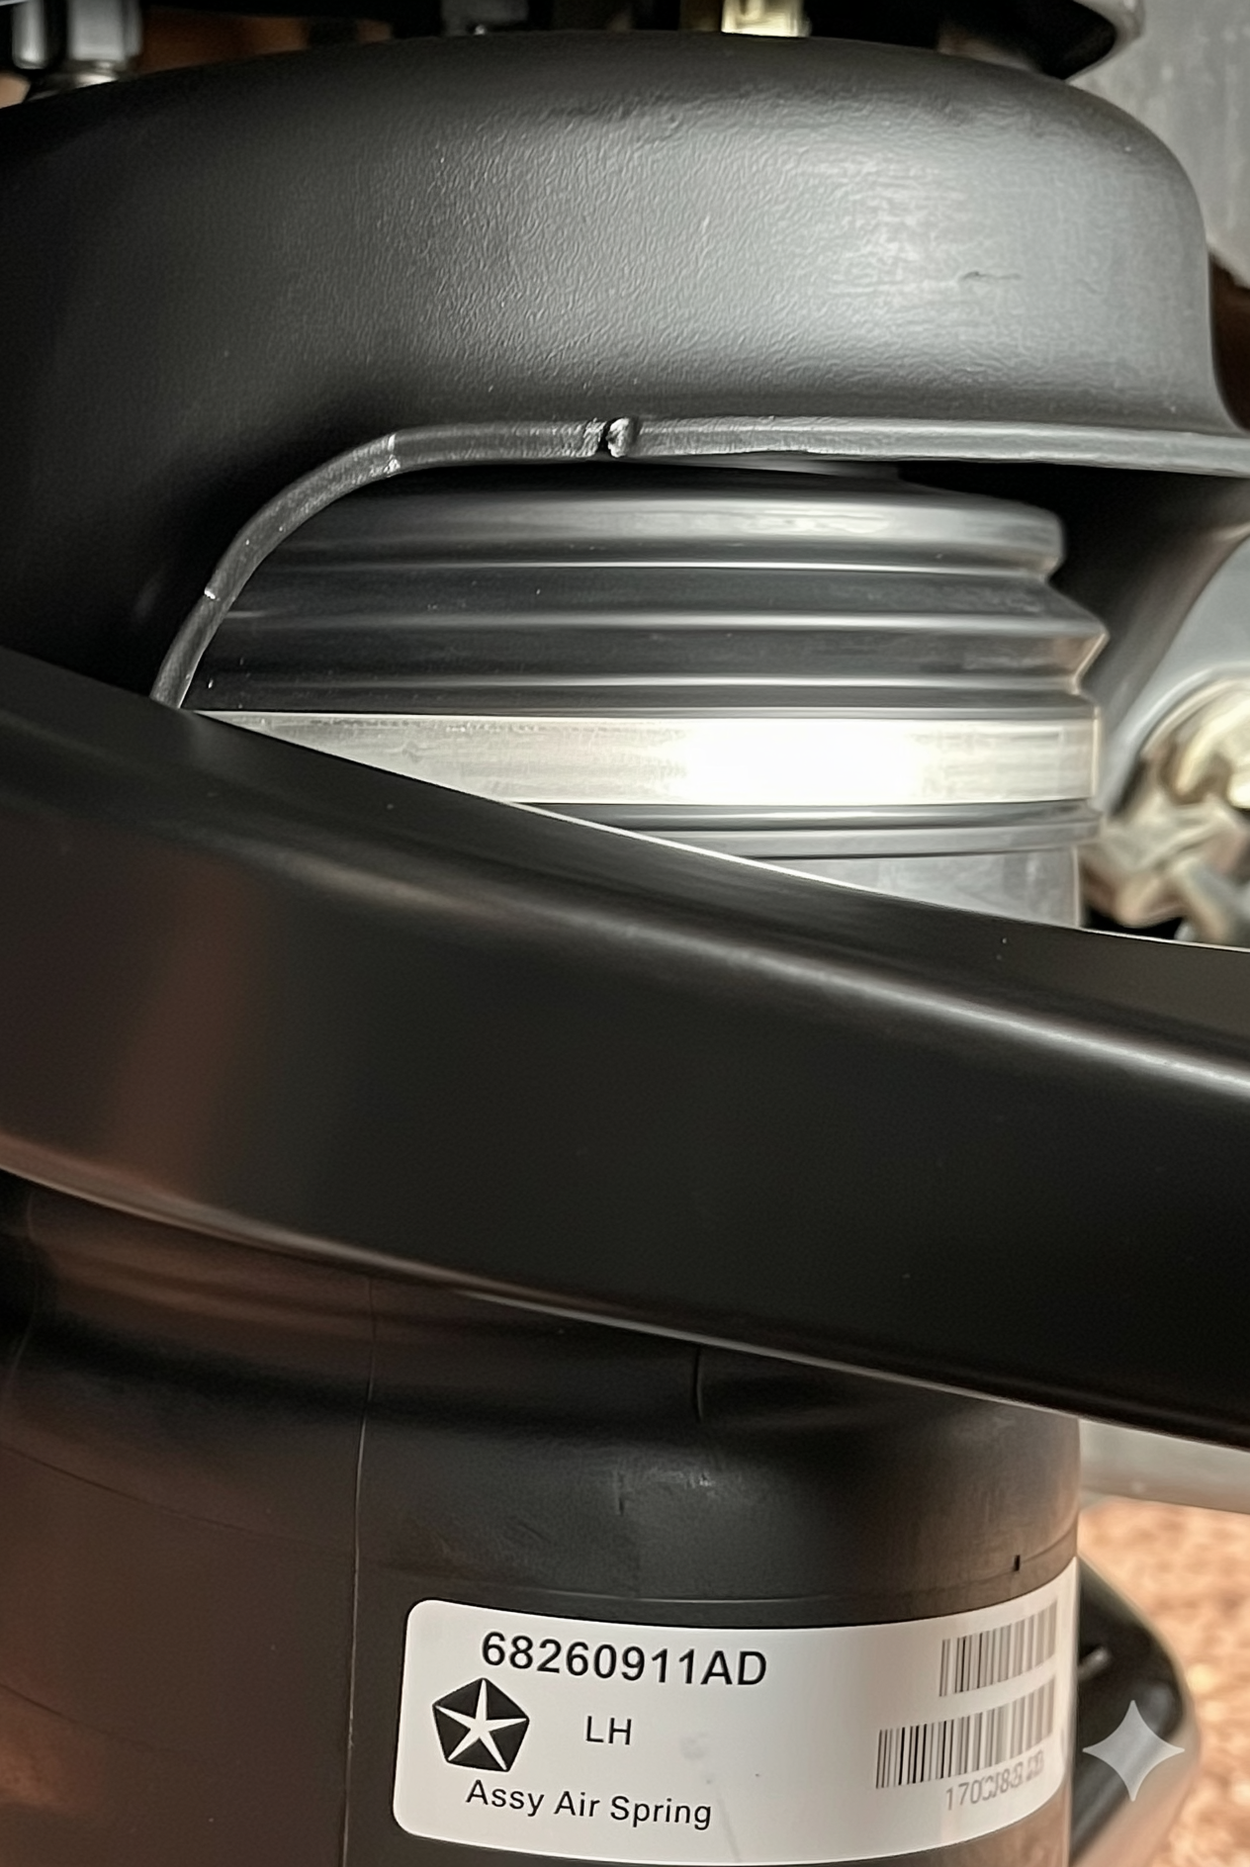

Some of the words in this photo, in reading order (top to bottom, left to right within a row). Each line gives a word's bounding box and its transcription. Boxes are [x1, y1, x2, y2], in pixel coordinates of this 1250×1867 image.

[481, 1631, 768, 1687] 68260911AD
[585, 1714, 633, 1747] LH
[465, 1778, 546, 1818] Assy
[553, 1789, 602, 1818] Air
[609, 1794, 712, 1832] Spring
